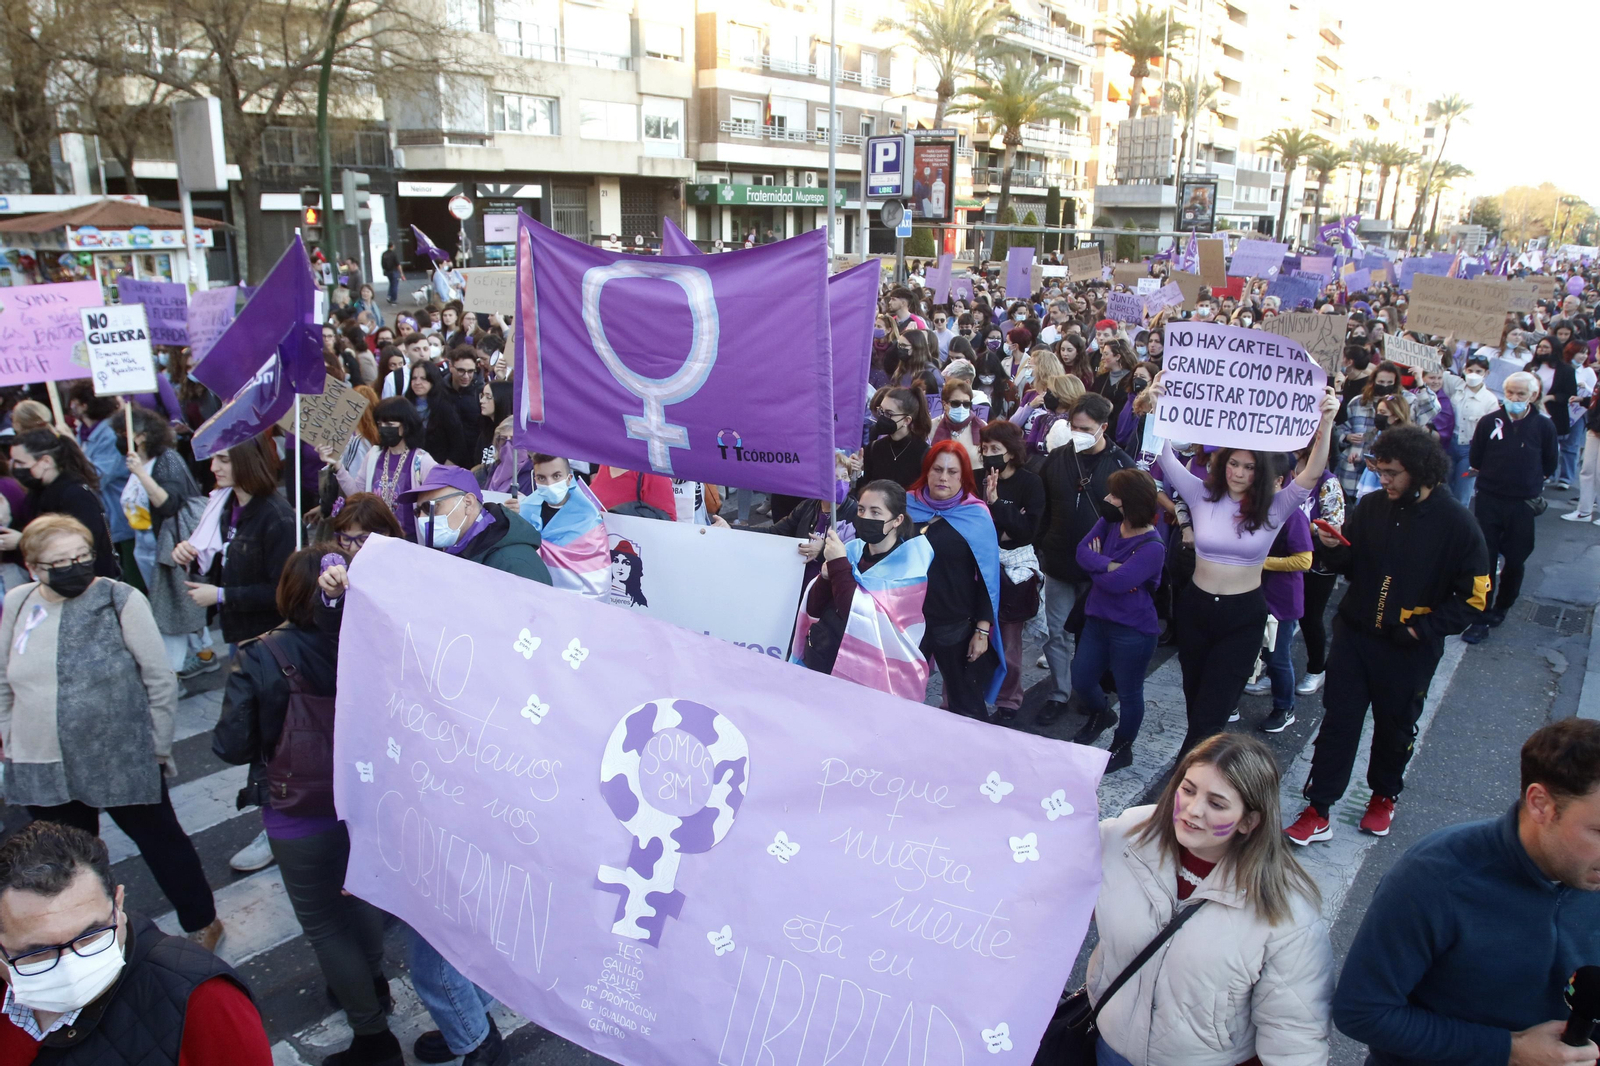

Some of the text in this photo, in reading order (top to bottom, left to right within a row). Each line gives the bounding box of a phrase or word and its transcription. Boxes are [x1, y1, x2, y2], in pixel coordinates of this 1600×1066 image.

[875, 142, 896, 172] P
[747, 187, 824, 202] Fraternidad Muprespa
[474, 275, 516, 288] GÉNER
[473, 298, 514, 308] OPRESIO
[1110, 303, 1134, 316] LIBRES
[87, 313, 108, 329] NO
[1264, 314, 1319, 335] FEMINISMO
[88, 329, 146, 345] GUERRA
[1169, 332, 1193, 347] NO
[1197, 333, 1226, 350] HAY
[1228, 338, 1284, 358] CARTEL
[1167, 355, 1314, 386] GRANDE COMO PARA
[306, 379, 347, 442] LA VIOLACIÓN
[1164, 380, 1316, 413] REGISTRAR TODO POR
[321, 428, 330, 440] ES
[1159, 406, 1318, 437] LO QUE PROTESTAMOS
[744, 449, 800, 464] CÓRDOBA
[401, 622, 474, 700] NO
[386, 693, 562, 802] necesitamos
[644, 733, 711, 786] SOMOS
[411, 760, 465, 804] que
[658, 772, 692, 805] 8M
[817, 758, 956, 831] porque
[483, 797, 540, 845] nos
[783, 910, 854, 959] está
[872, 897, 1016, 959] mente
[601, 969, 638, 991] GALILEI
[603, 957, 644, 980] GALILEO
[869, 949, 913, 980] en
[581, 999, 651, 1035] DE IGUALDAD DE
[600, 990, 657, 1021] PROMOCIÓN
